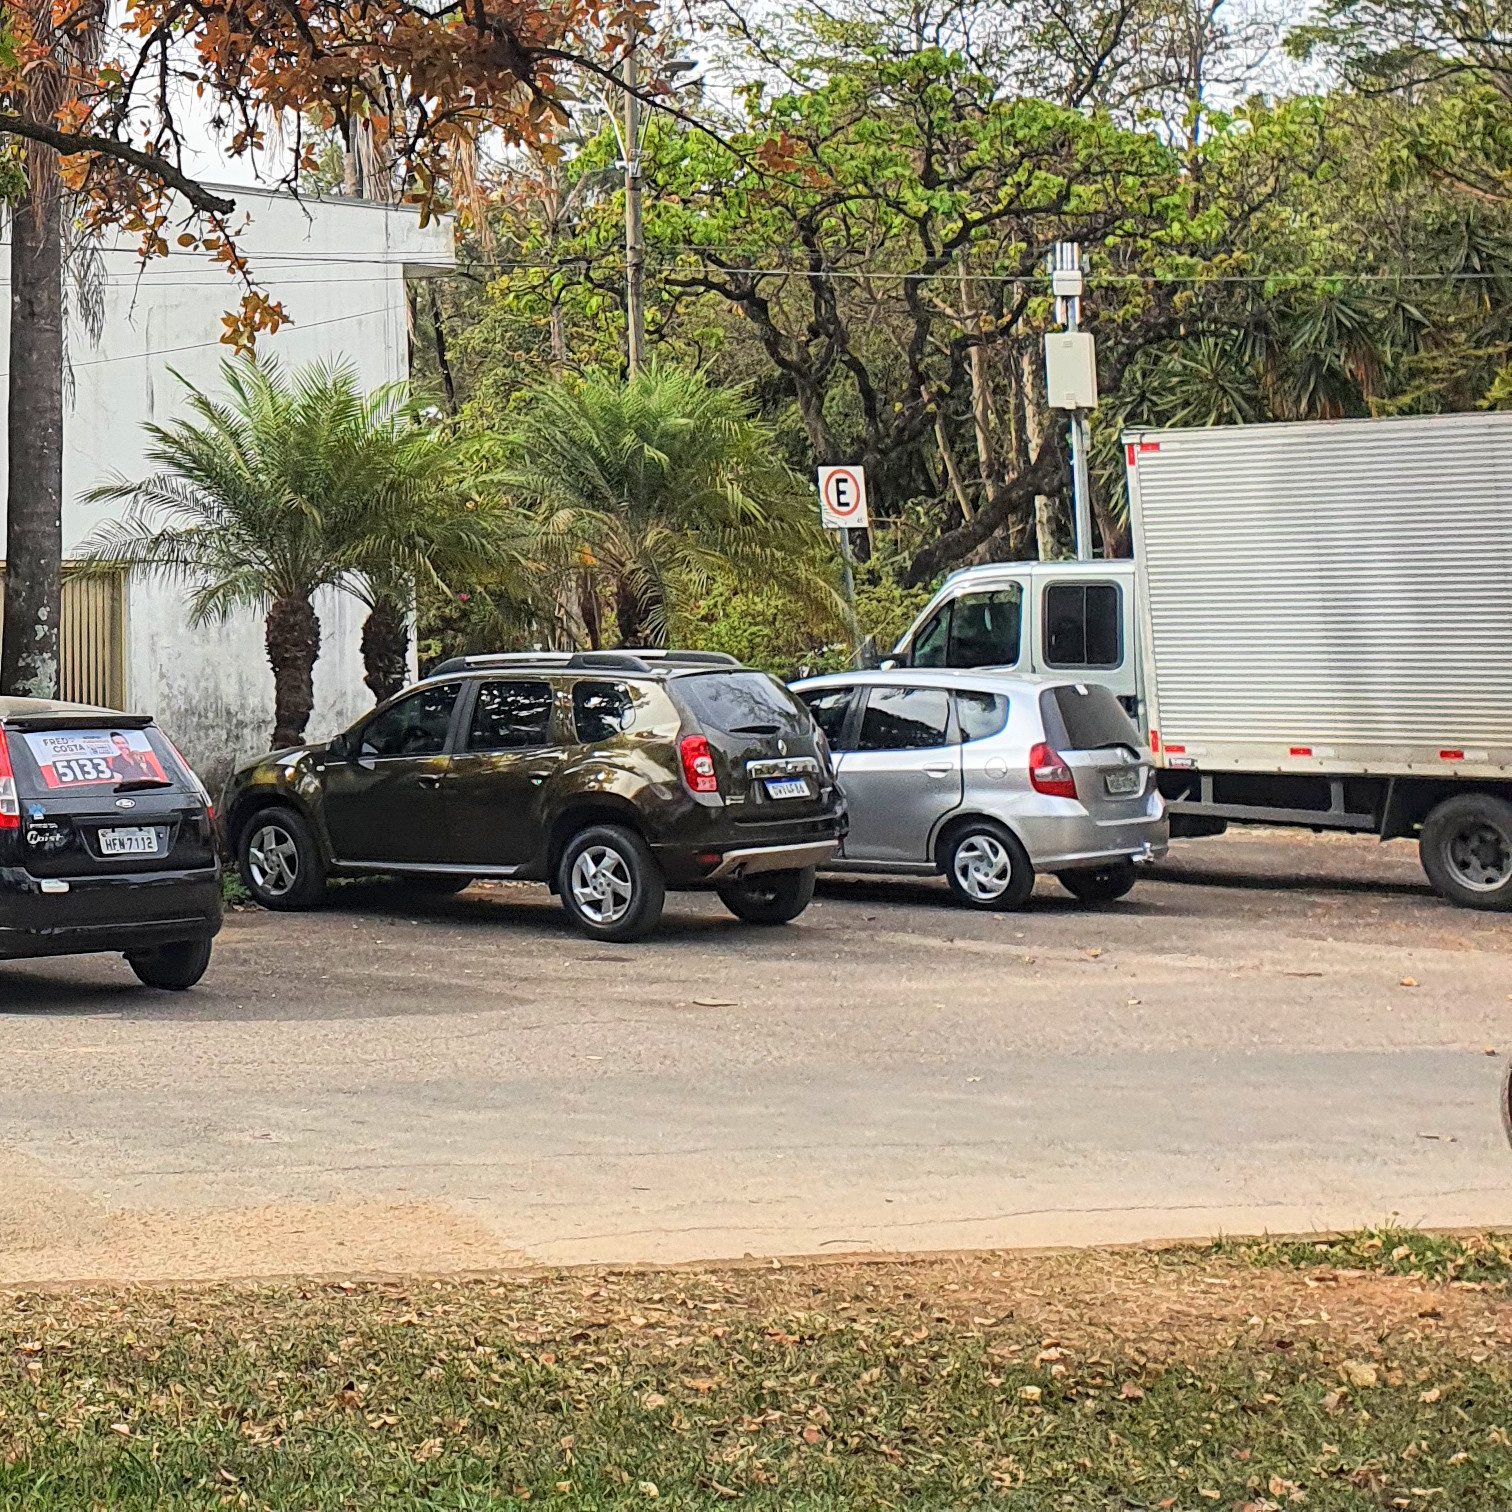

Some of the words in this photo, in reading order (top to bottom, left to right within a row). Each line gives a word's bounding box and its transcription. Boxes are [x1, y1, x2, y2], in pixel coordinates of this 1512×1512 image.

[835, 478, 850, 507] E
[42, 737, 68, 746] FRED
[52, 744, 86, 753] COSTA
[55, 758, 113, 782] 5133
